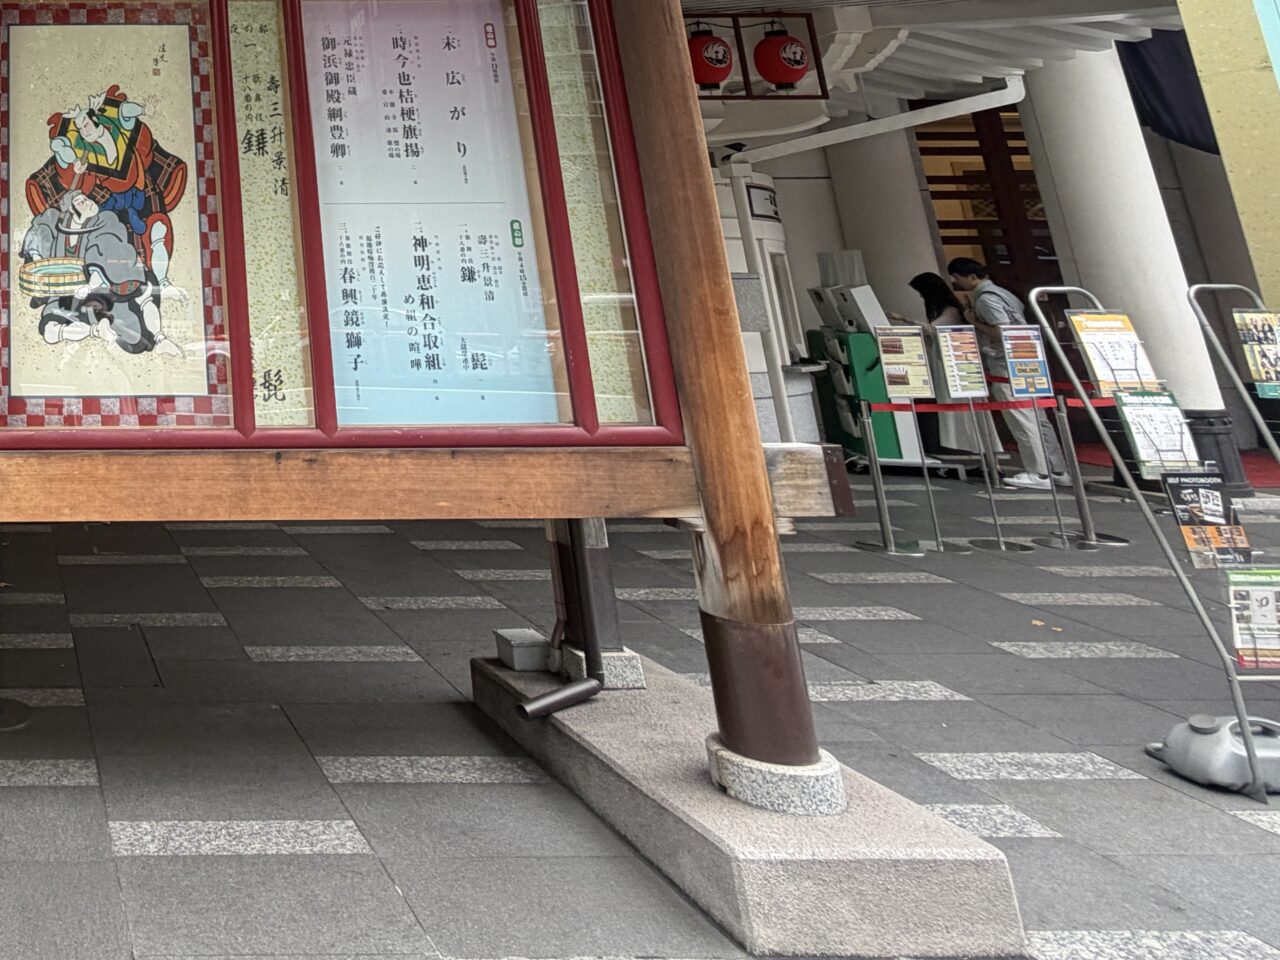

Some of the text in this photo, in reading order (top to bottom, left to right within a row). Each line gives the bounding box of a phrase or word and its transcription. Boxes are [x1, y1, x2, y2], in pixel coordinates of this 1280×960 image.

[230, 24, 269, 35] 夜の部
[343, 36, 357, 96] 元禄忠臣蔵
[340, 266, 362, 372] 春興鏡獅子
